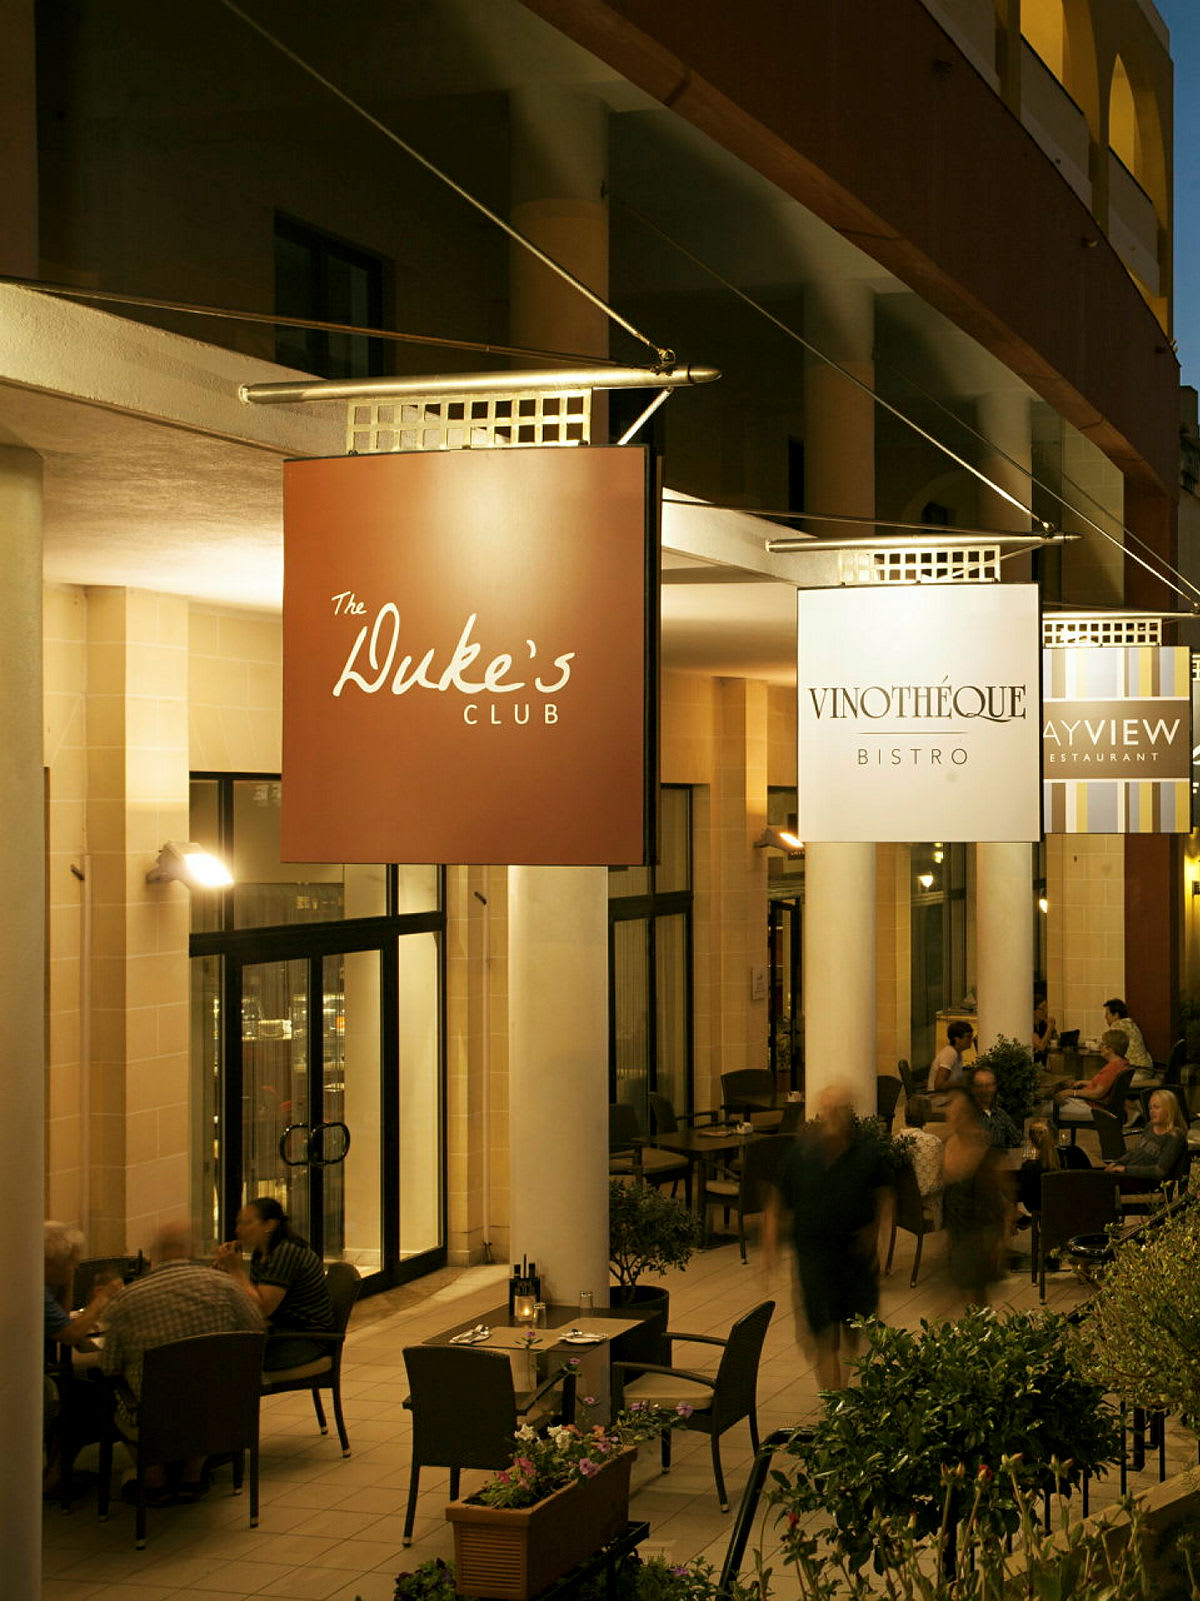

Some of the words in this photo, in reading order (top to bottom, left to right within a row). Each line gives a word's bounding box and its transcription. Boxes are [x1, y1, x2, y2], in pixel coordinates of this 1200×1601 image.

[331, 591, 367, 615] The
[332, 602, 575, 697] Duke's
[808, 675, 1026, 722] VINOTHÉQUE
[463, 703, 559, 725] CLUB
[1043, 718, 1180, 746] AYVIEW
[857, 748, 968, 765] BISTRO
[1049, 752, 1159, 763] ESTAURANT
